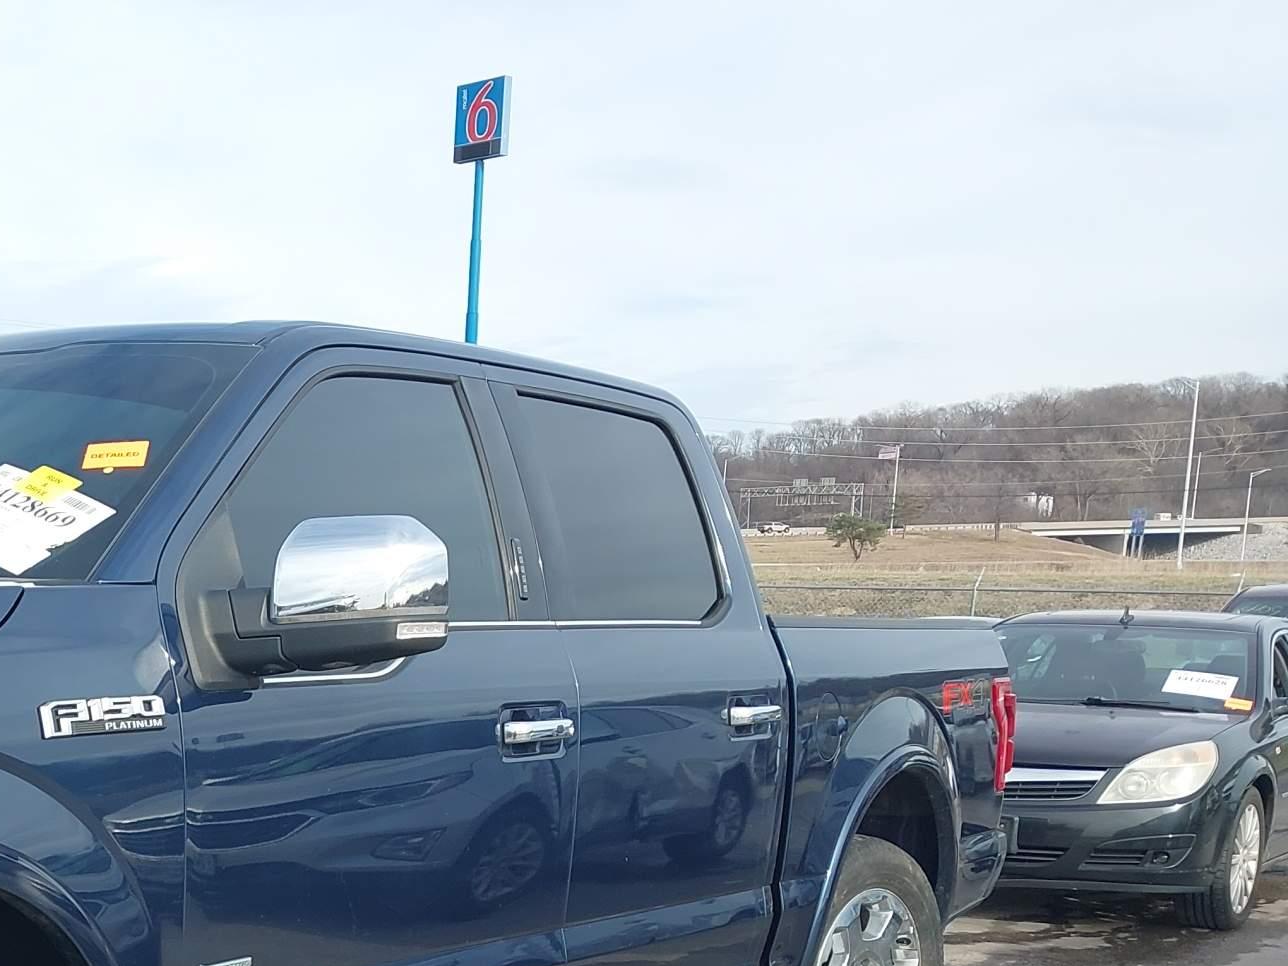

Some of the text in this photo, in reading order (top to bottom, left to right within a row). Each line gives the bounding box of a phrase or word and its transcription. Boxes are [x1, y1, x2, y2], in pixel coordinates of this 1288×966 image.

[466, 80, 498, 144] 6
[90, 450, 141, 459] DETAILED
[105, 718, 163, 731] PLATINUM
